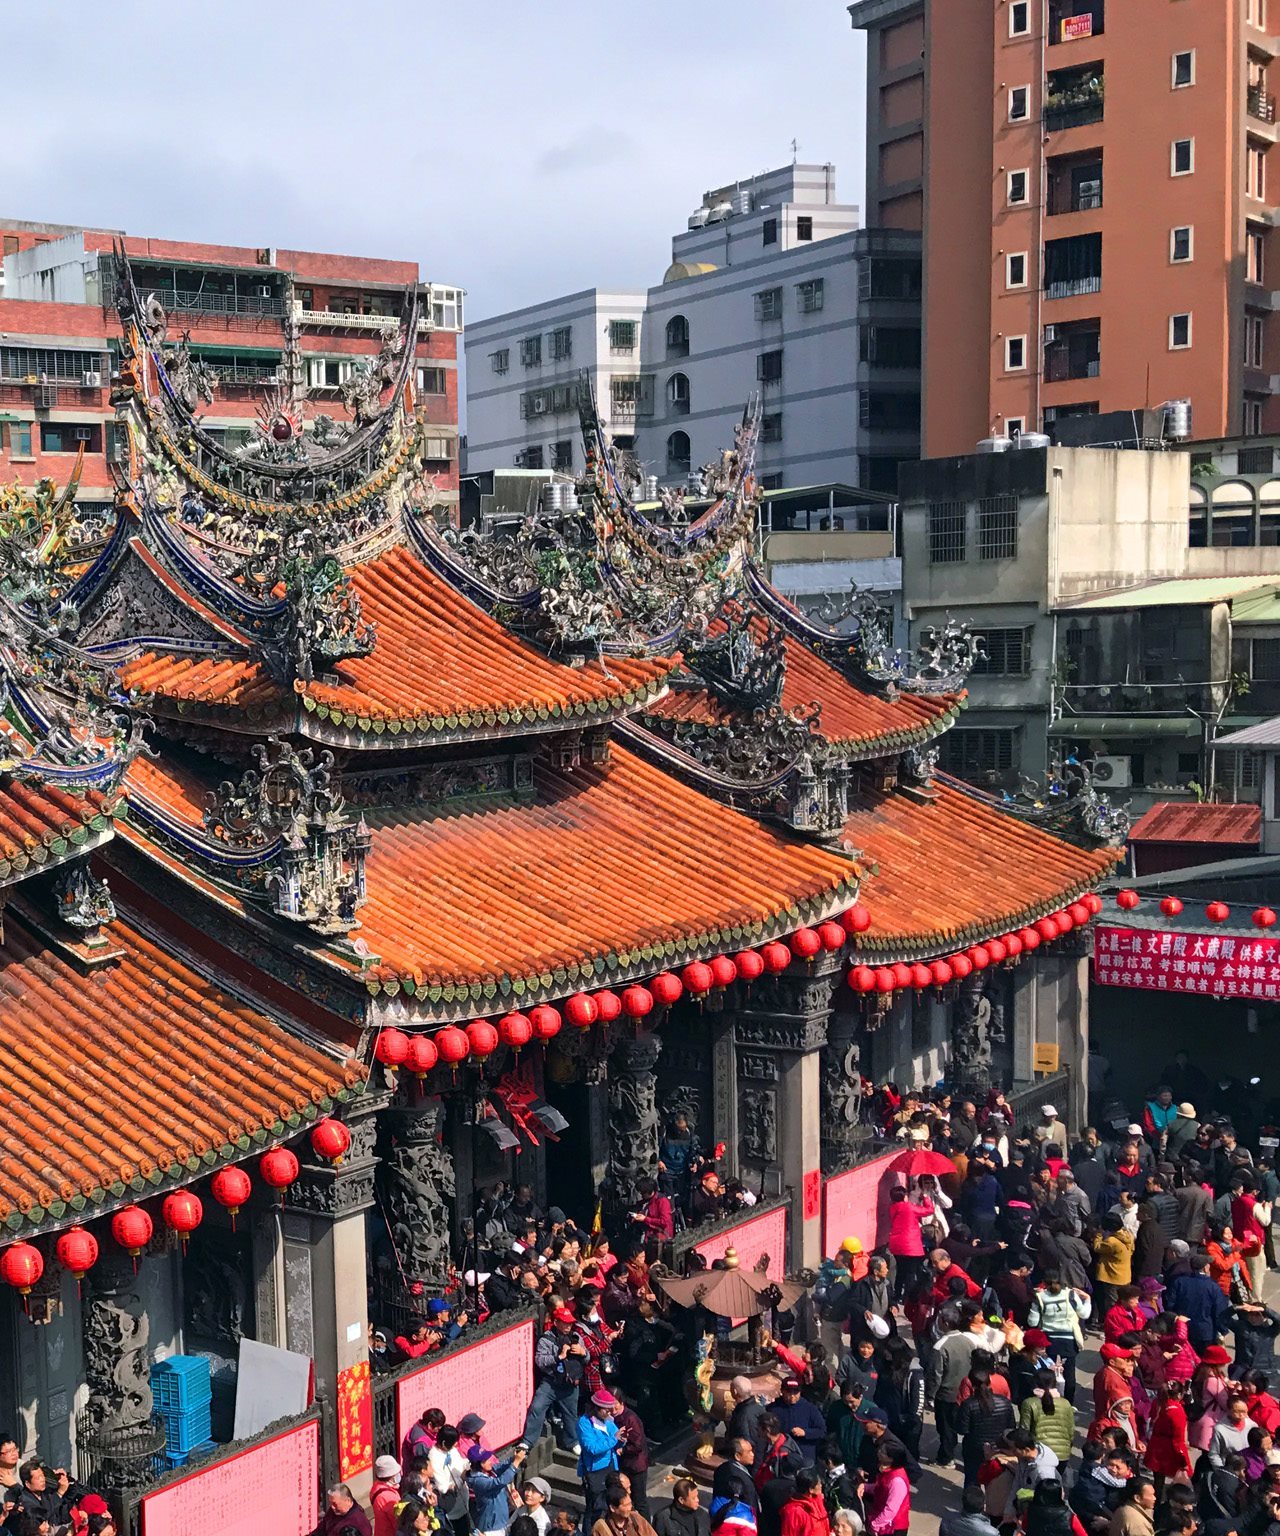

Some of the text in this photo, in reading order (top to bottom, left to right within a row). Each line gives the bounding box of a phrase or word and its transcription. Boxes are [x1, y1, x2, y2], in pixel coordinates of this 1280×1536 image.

[1146, 933, 1187, 957] 文昌殿
[1191, 936, 1236, 960] 太歲殿
[1240, 944, 1280, 965] 供奉文
[1214, 979, 1280, 998] 請至本巖服
